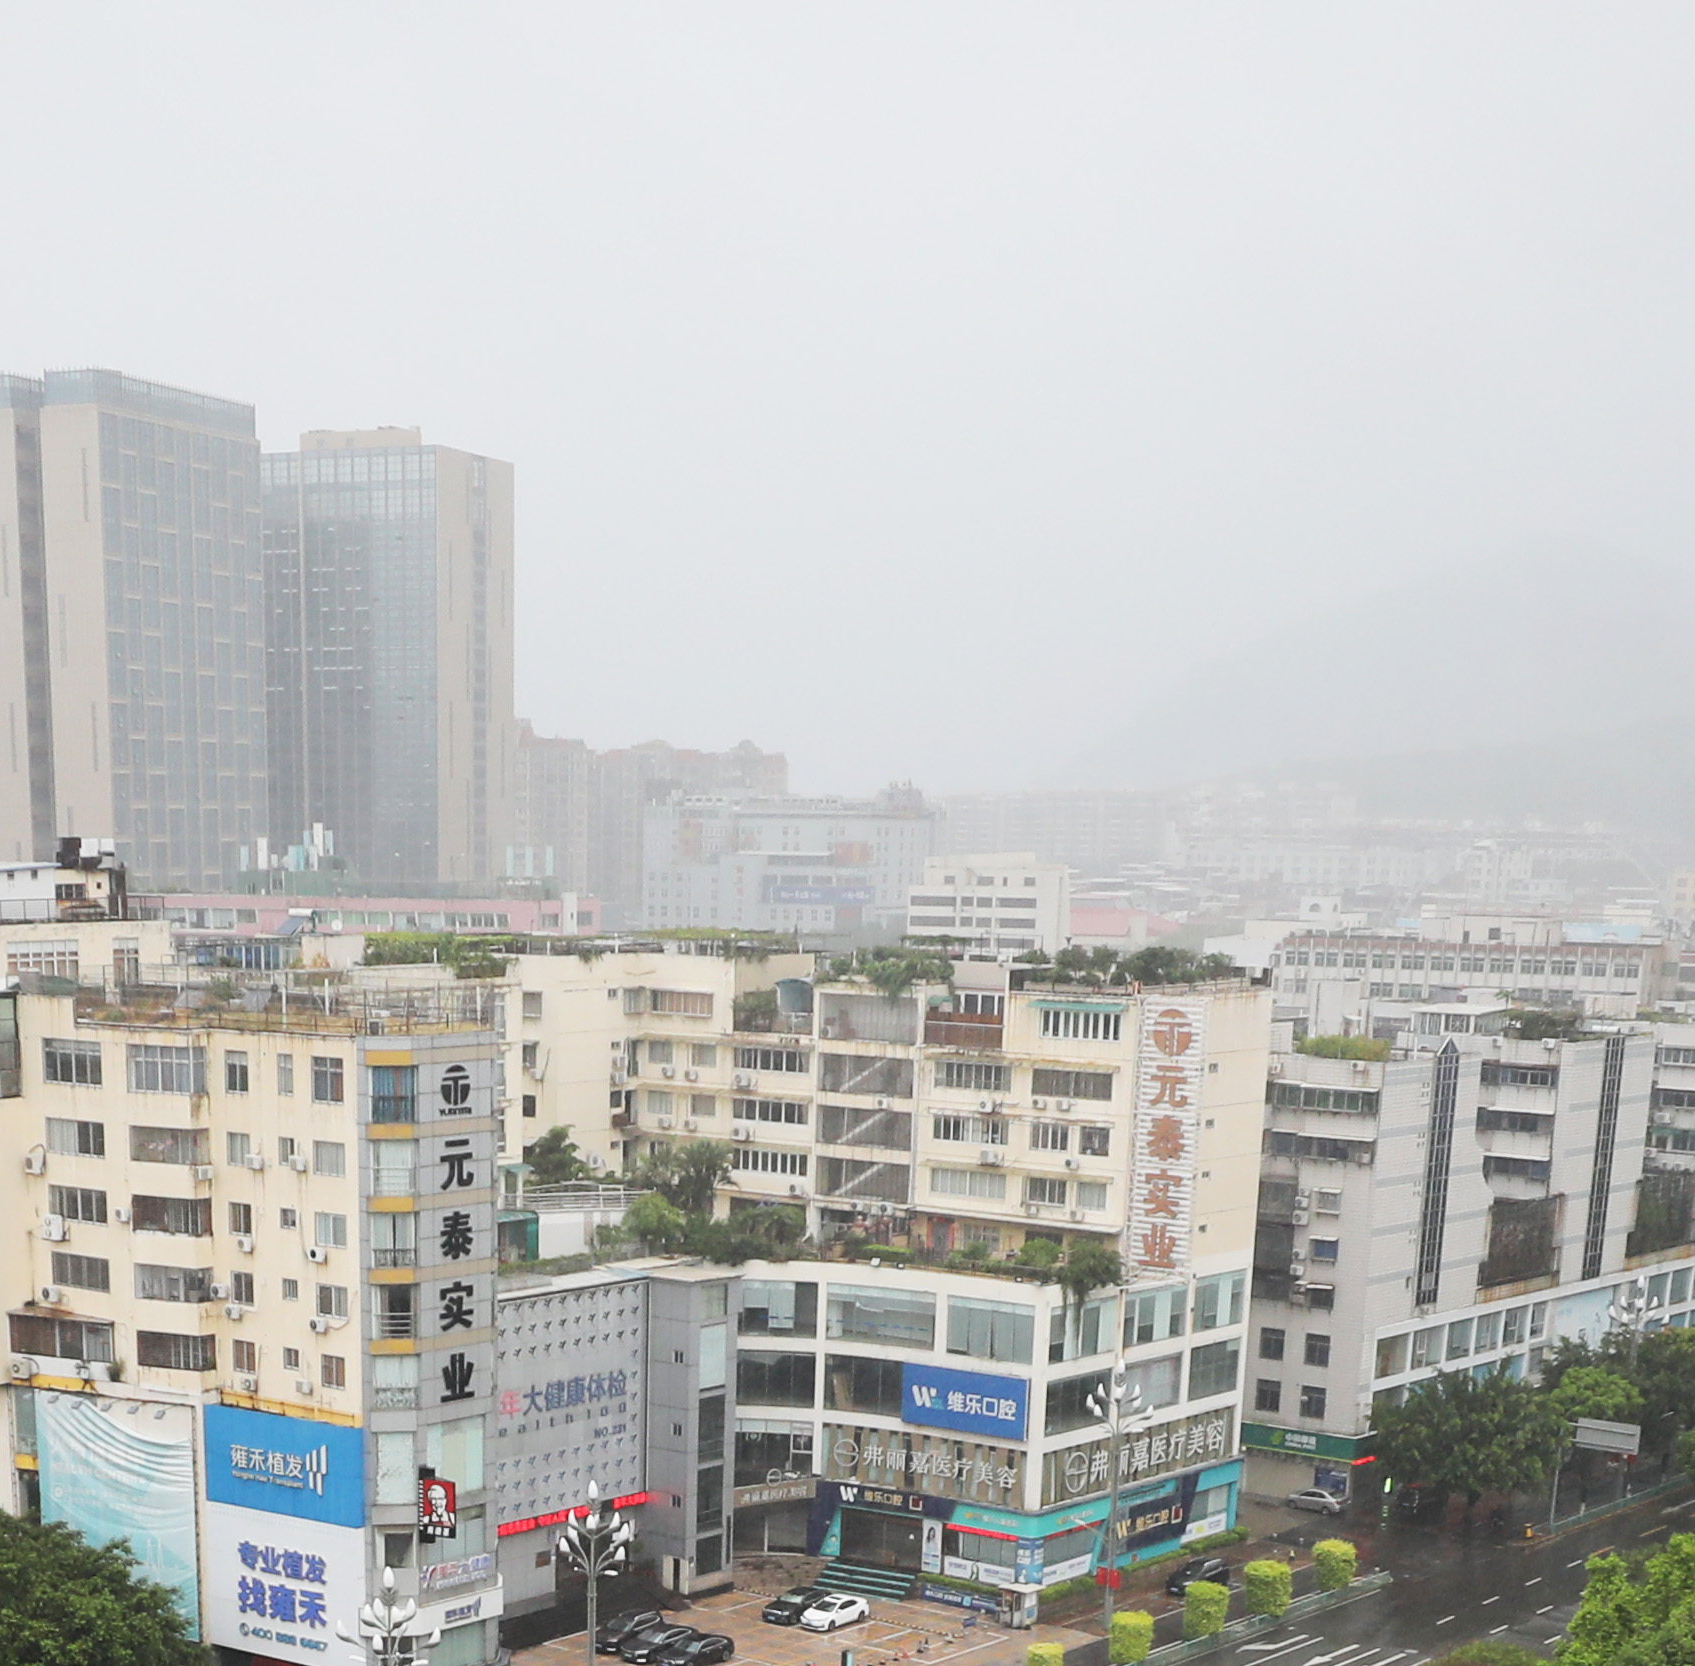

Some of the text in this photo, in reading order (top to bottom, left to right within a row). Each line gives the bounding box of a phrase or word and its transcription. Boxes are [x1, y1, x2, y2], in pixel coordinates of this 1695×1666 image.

[1139, 1065, 1188, 1270] 元泰实业
[439, 1138, 476, 1404] 元泰实业
[947, 1389, 1017, 1420] 维乐口腔
[230, 1443, 305, 1479] 雍禾植发
[862, 1443, 1019, 1490] 弗丽嘉医疗美容
[237, 1540, 327, 1586] 专业植发
[237, 1574, 328, 1629] 找雍禾
